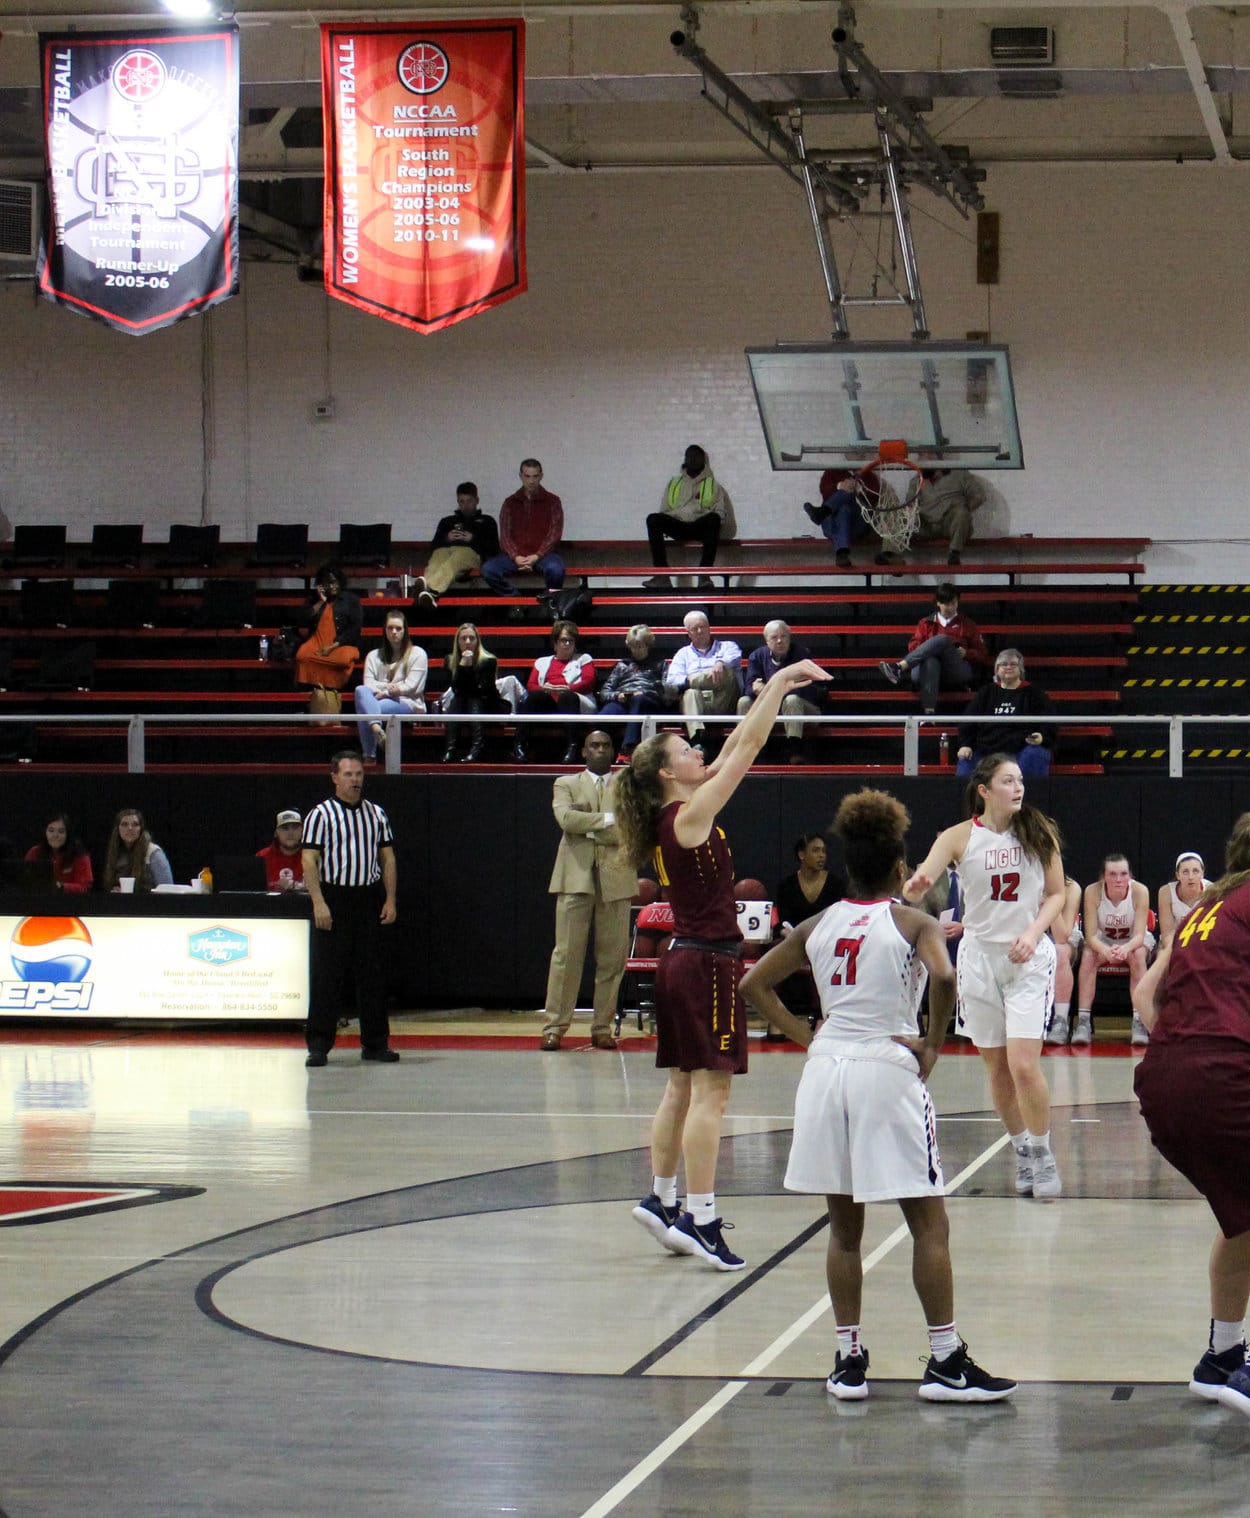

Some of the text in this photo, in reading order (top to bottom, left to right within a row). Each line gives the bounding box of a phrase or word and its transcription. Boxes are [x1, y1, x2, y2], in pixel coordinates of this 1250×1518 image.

[393, 104, 457, 119] NCCAA
[372, 124, 479, 139] Tournament
[339, 38, 360, 284] WOMEN'S BASKETBALL
[401, 148, 449, 161] South
[397, 165, 455, 180] Region
[381, 181, 472, 196] Champions
[393, 197, 461, 210] 2003-04
[393, 213, 461, 227] 2005-06
[393, 229, 460, 242] 2010-11
[91, 236, 187, 251] Tournament
[95, 256, 179, 275] Runner-Up
[105, 274, 170, 289] 2005-06
[994, 705, 1016, 715] 1947
[984, 846, 1022, 871] NGU
[990, 872, 1020, 902] 12
[1104, 913, 1128, 927] NGU
[1178, 900, 1225, 948] 44
[1104, 927, 1130, 940] 22
[0, 981, 95, 1011] EPSI
[160, 1001, 211, 1012] Reservation
[719, 1034, 731, 1051] E
